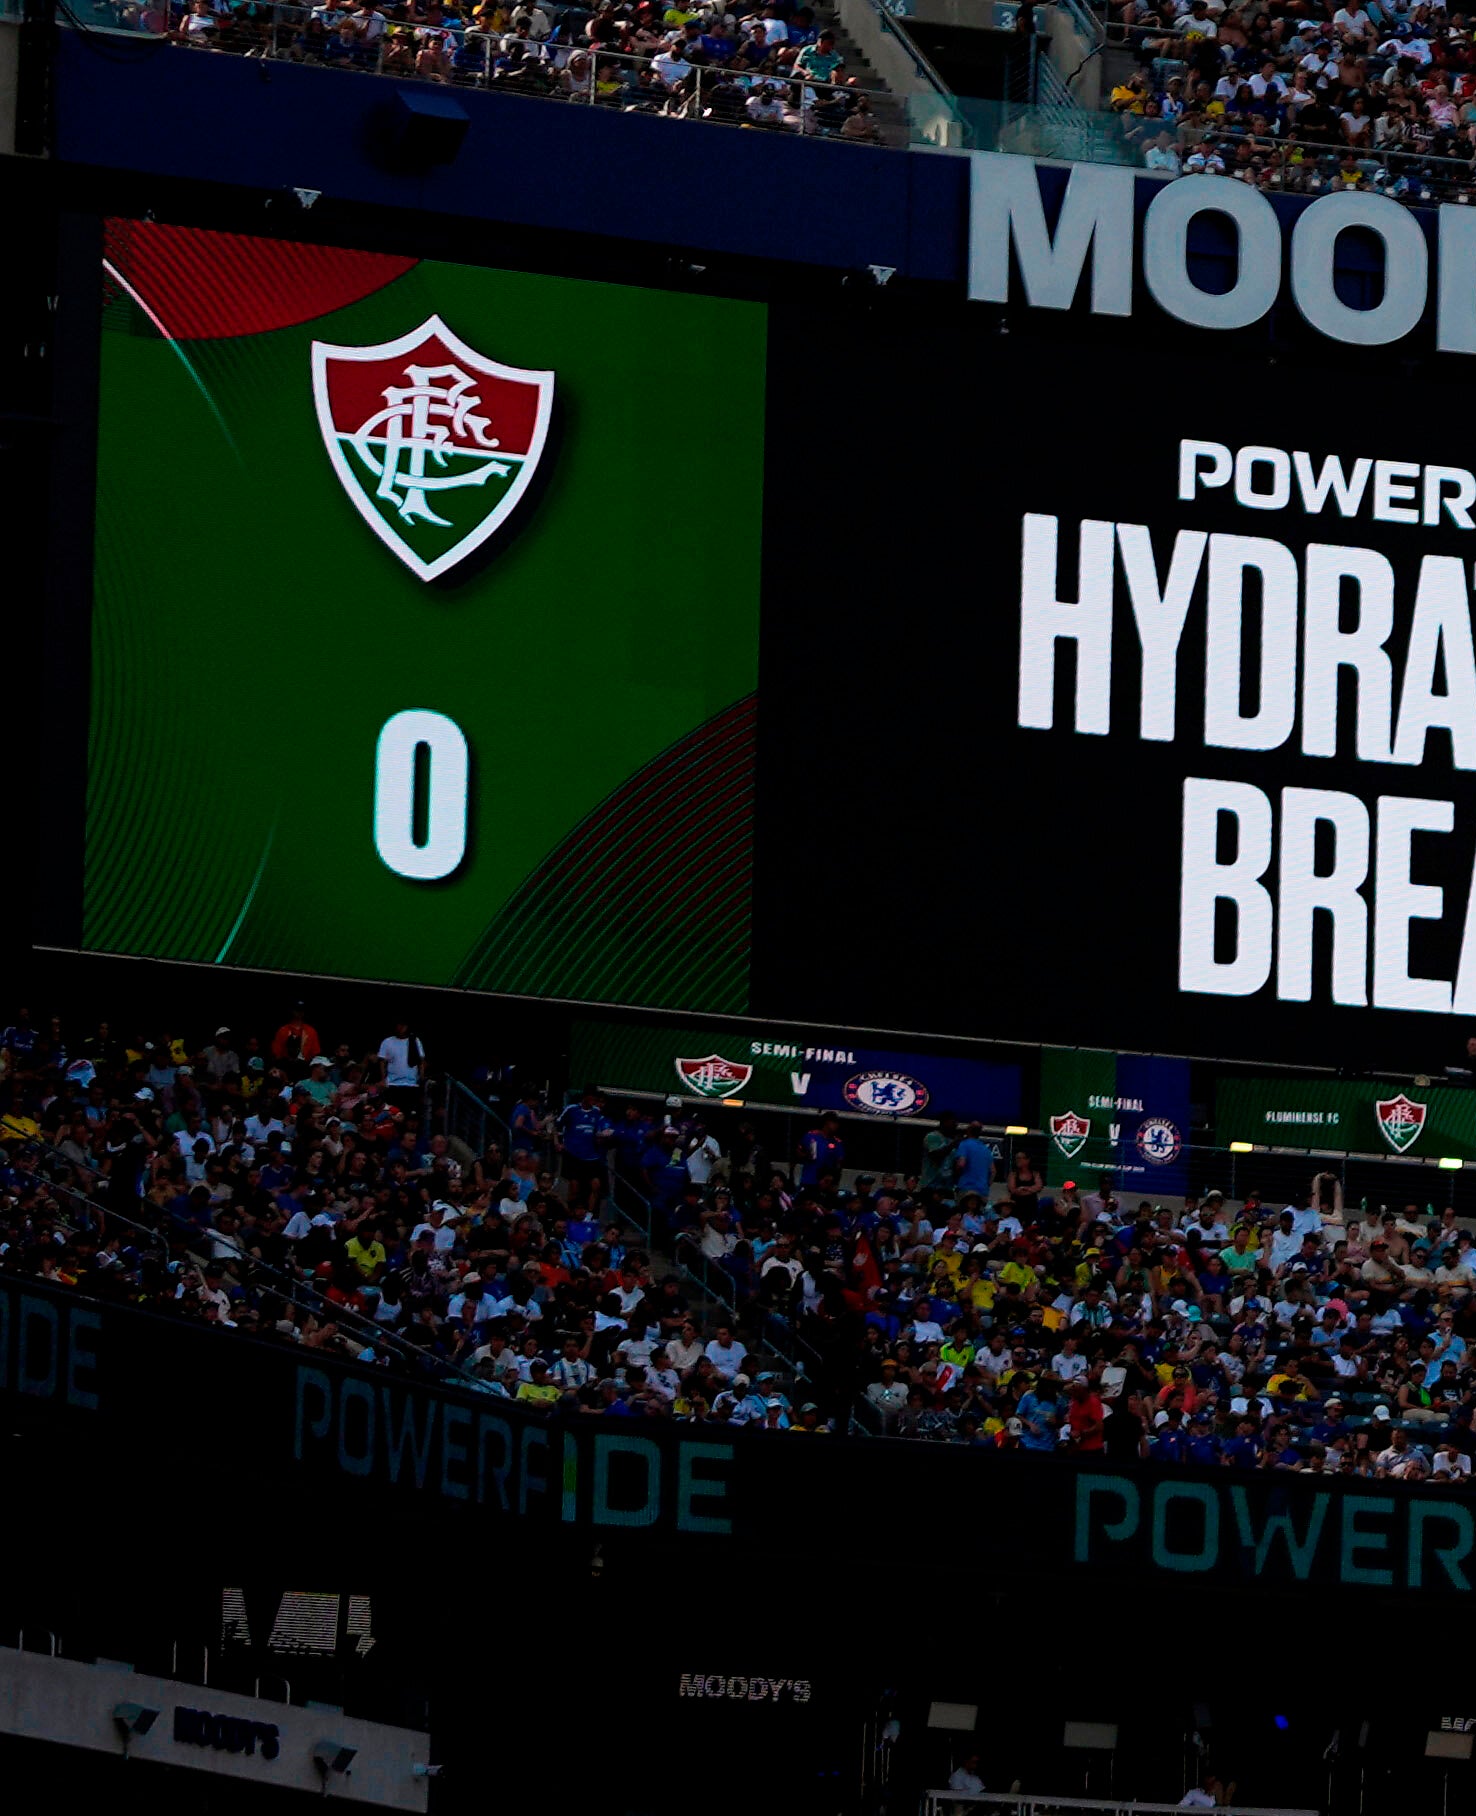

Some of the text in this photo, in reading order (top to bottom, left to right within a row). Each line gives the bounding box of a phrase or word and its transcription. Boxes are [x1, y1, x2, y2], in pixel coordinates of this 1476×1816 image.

[374, 707, 470, 880] 0
[750, 1041, 857, 1066] SEMI-FINAL
[790, 1071, 811, 1095] V
[1088, 1095, 1144, 1112] SEMI-FINAL
[1265, 1111, 1340, 1124] FLUMINENSE FC
[1109, 1123, 1121, 1147] V
[679, 1673, 812, 1703] MOODY'S
[174, 1706, 280, 1760] MOODY'S
